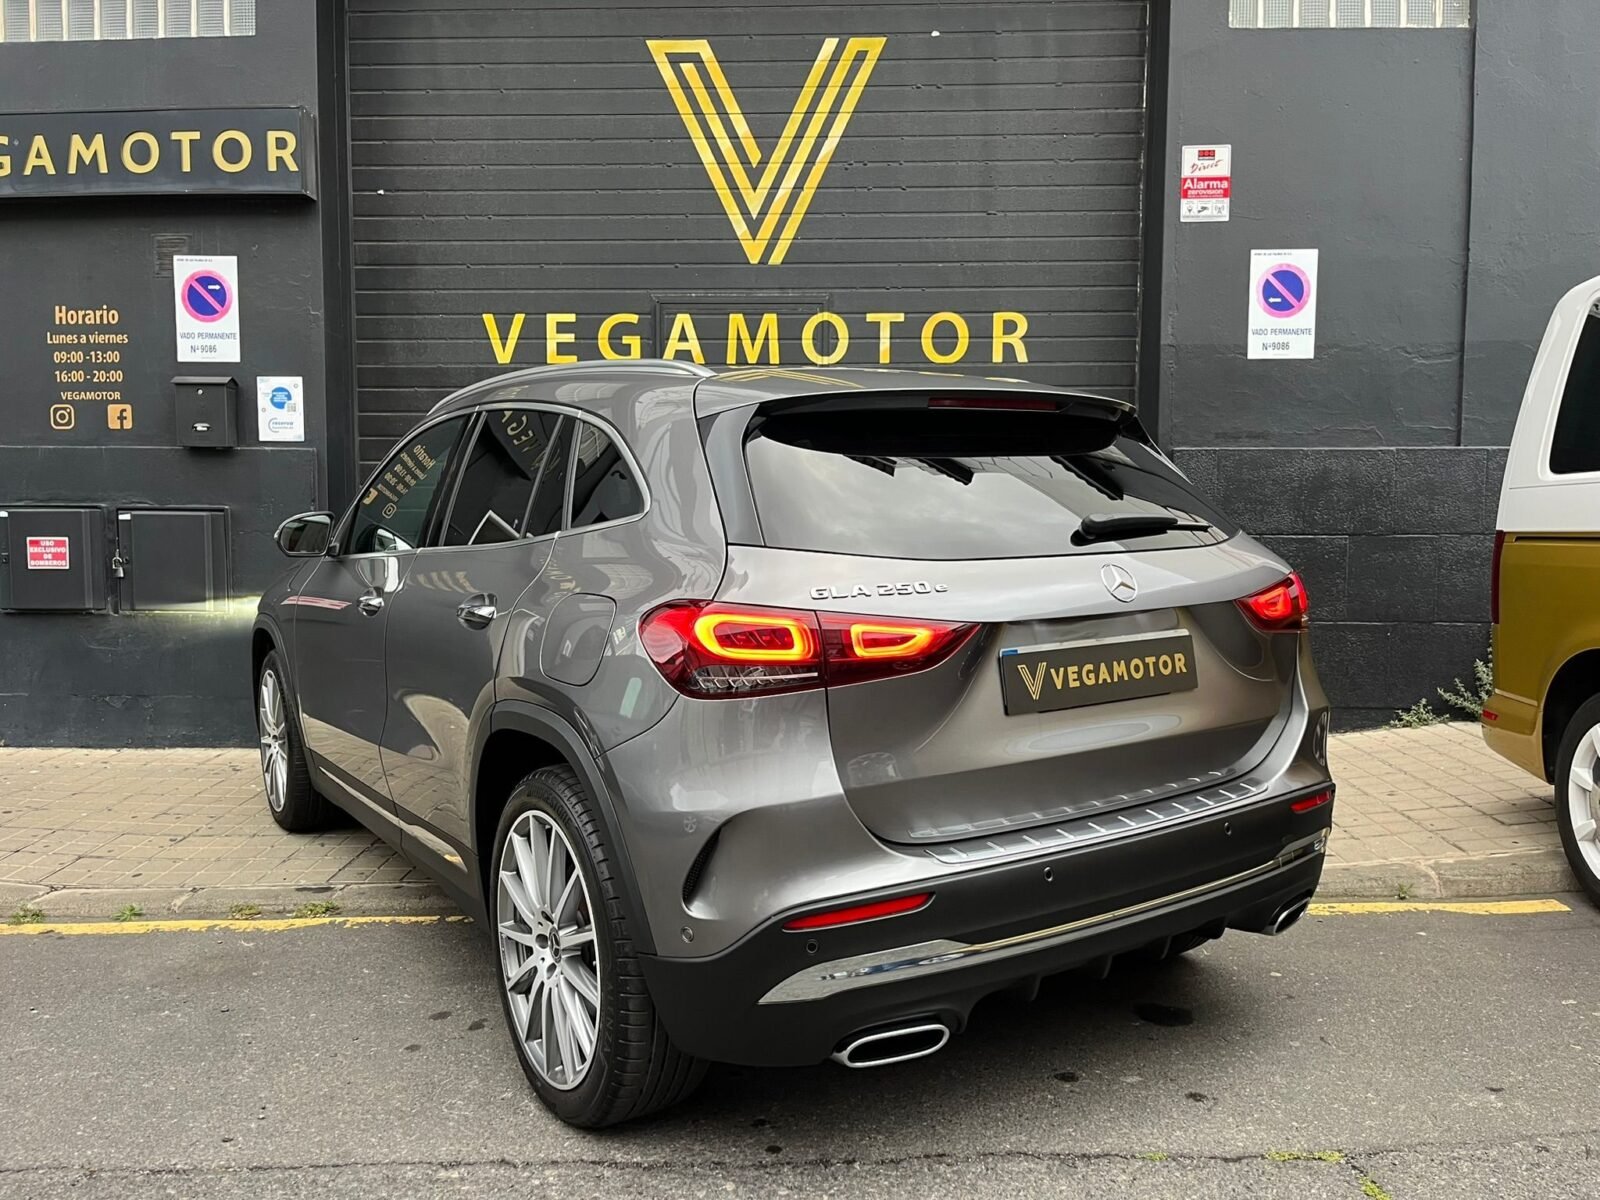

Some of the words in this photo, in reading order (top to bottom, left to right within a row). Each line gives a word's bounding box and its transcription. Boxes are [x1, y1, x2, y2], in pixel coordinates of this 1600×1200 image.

[1183, 177, 1228, 190] Alarma
[55, 304, 119, 325] Horario
[46, 332, 78, 344] Lunes
[80, 334, 87, 344] a
[88, 331, 129, 344] viernes
[179, 331, 196, 340] VADO
[197, 332, 238, 340] PERMANENTE
[482, 310, 1029, 365] VEGAMOTOR
[1251, 328, 1269, 336] VADO
[1270, 327, 1313, 336] PERMANENTE
[54, 351, 84, 363] 09:00
[54, 370, 85, 383] 16:00
[92, 370, 123, 383] 20:00
[60, 391, 121, 400] VEGAMOTOR
[809, 584, 872, 600] GLA
[1050, 653, 1188, 690] VEGAMOTOR
